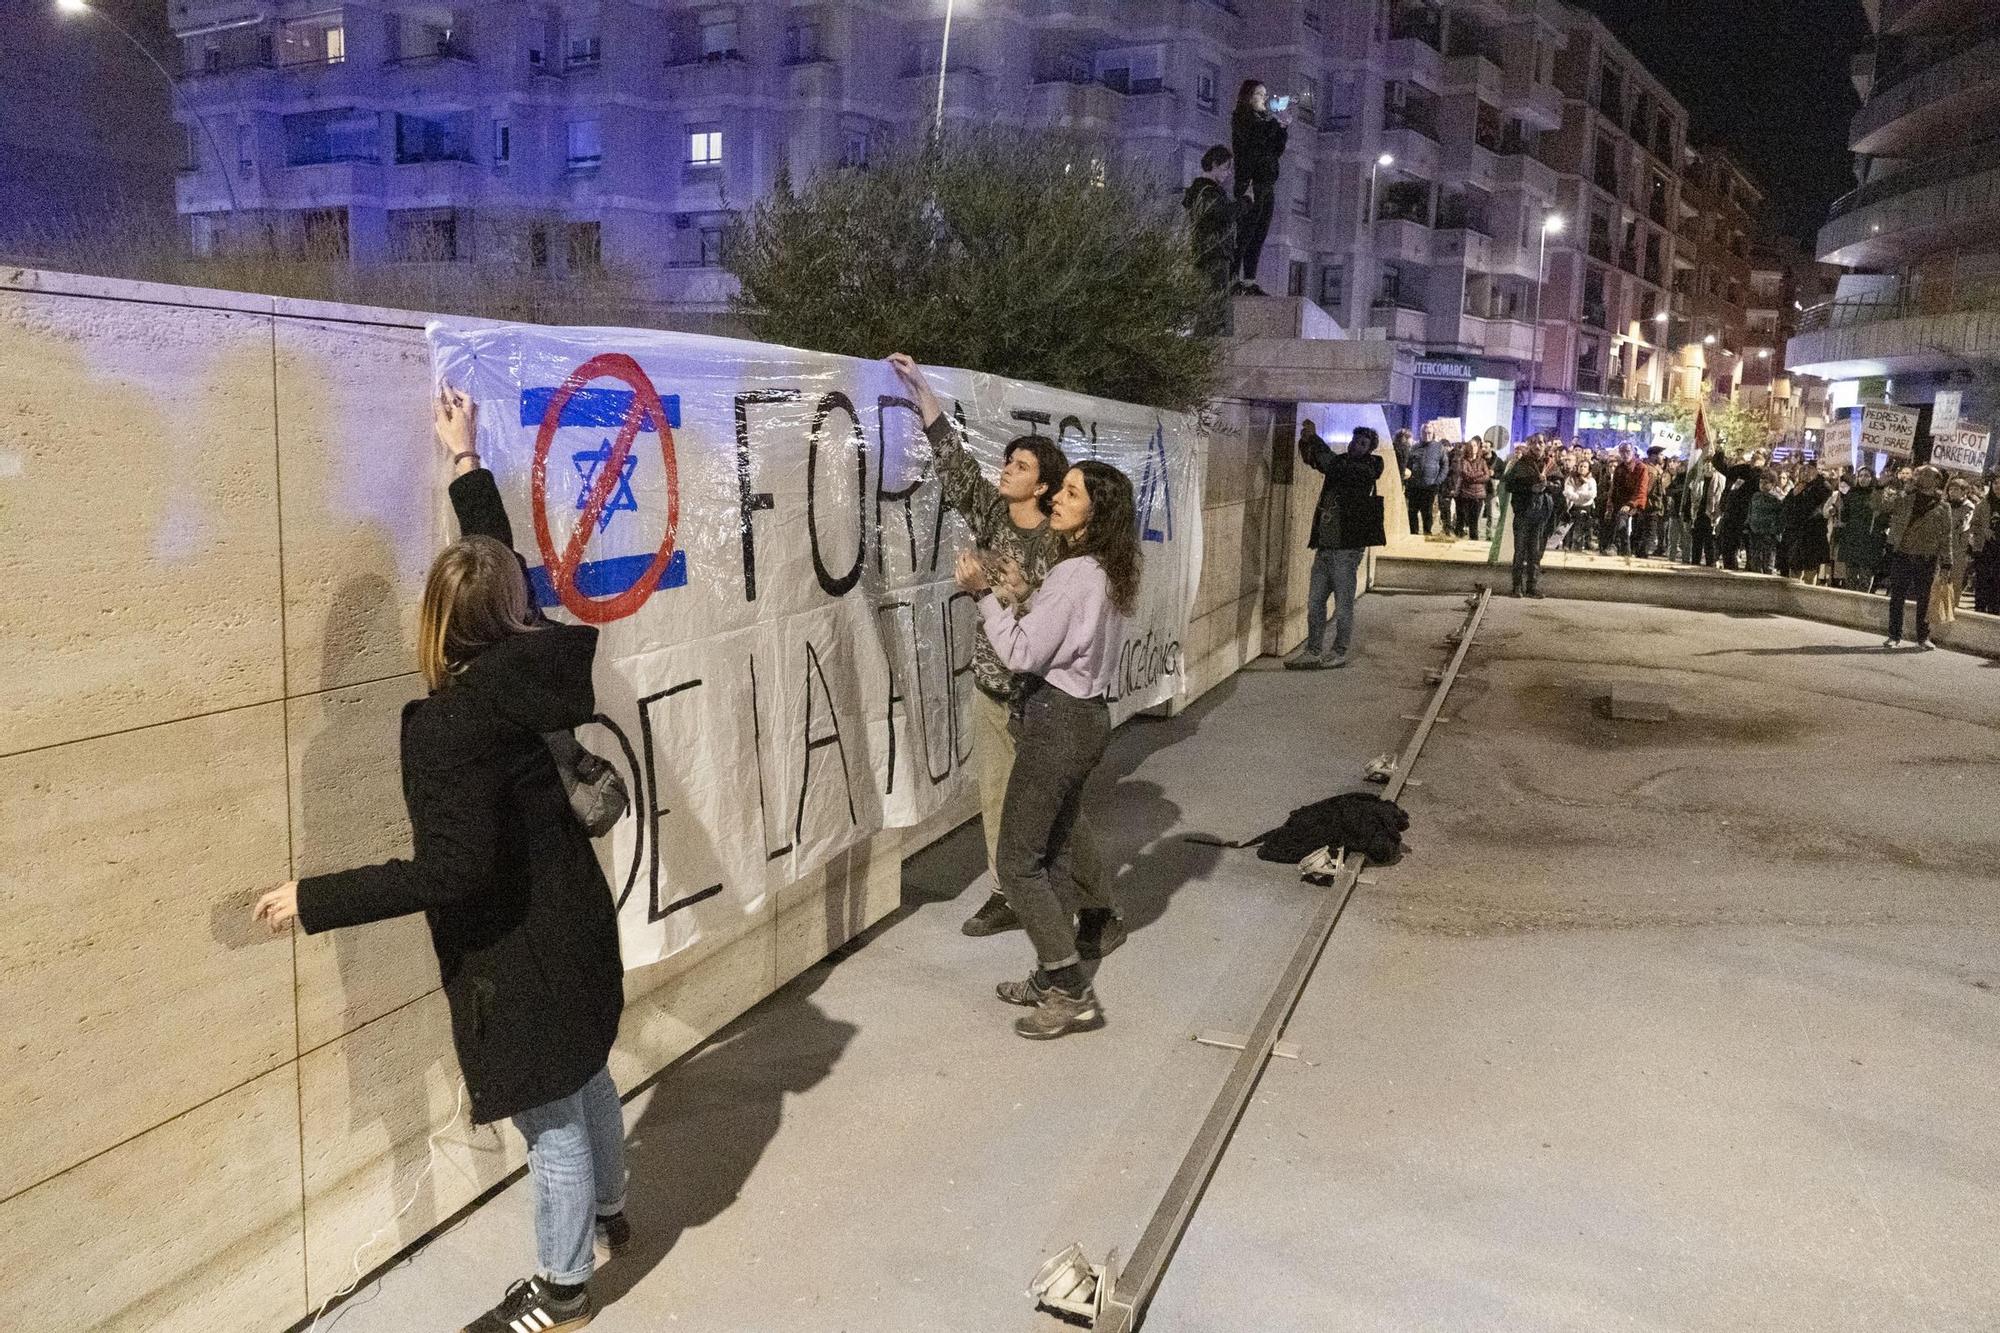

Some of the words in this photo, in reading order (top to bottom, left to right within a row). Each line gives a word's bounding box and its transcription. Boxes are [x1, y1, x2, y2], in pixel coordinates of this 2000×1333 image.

[1865, 410, 1899, 423] PEDRES
[1659, 430, 1682, 442] END
[1868, 420, 1886, 431] LES
[1888, 422, 1912, 436] MANS
[1862, 431, 1880, 444] FOC
[1883, 435, 1910, 451] ISRAEL
[749, 641, 857, 862] LA
